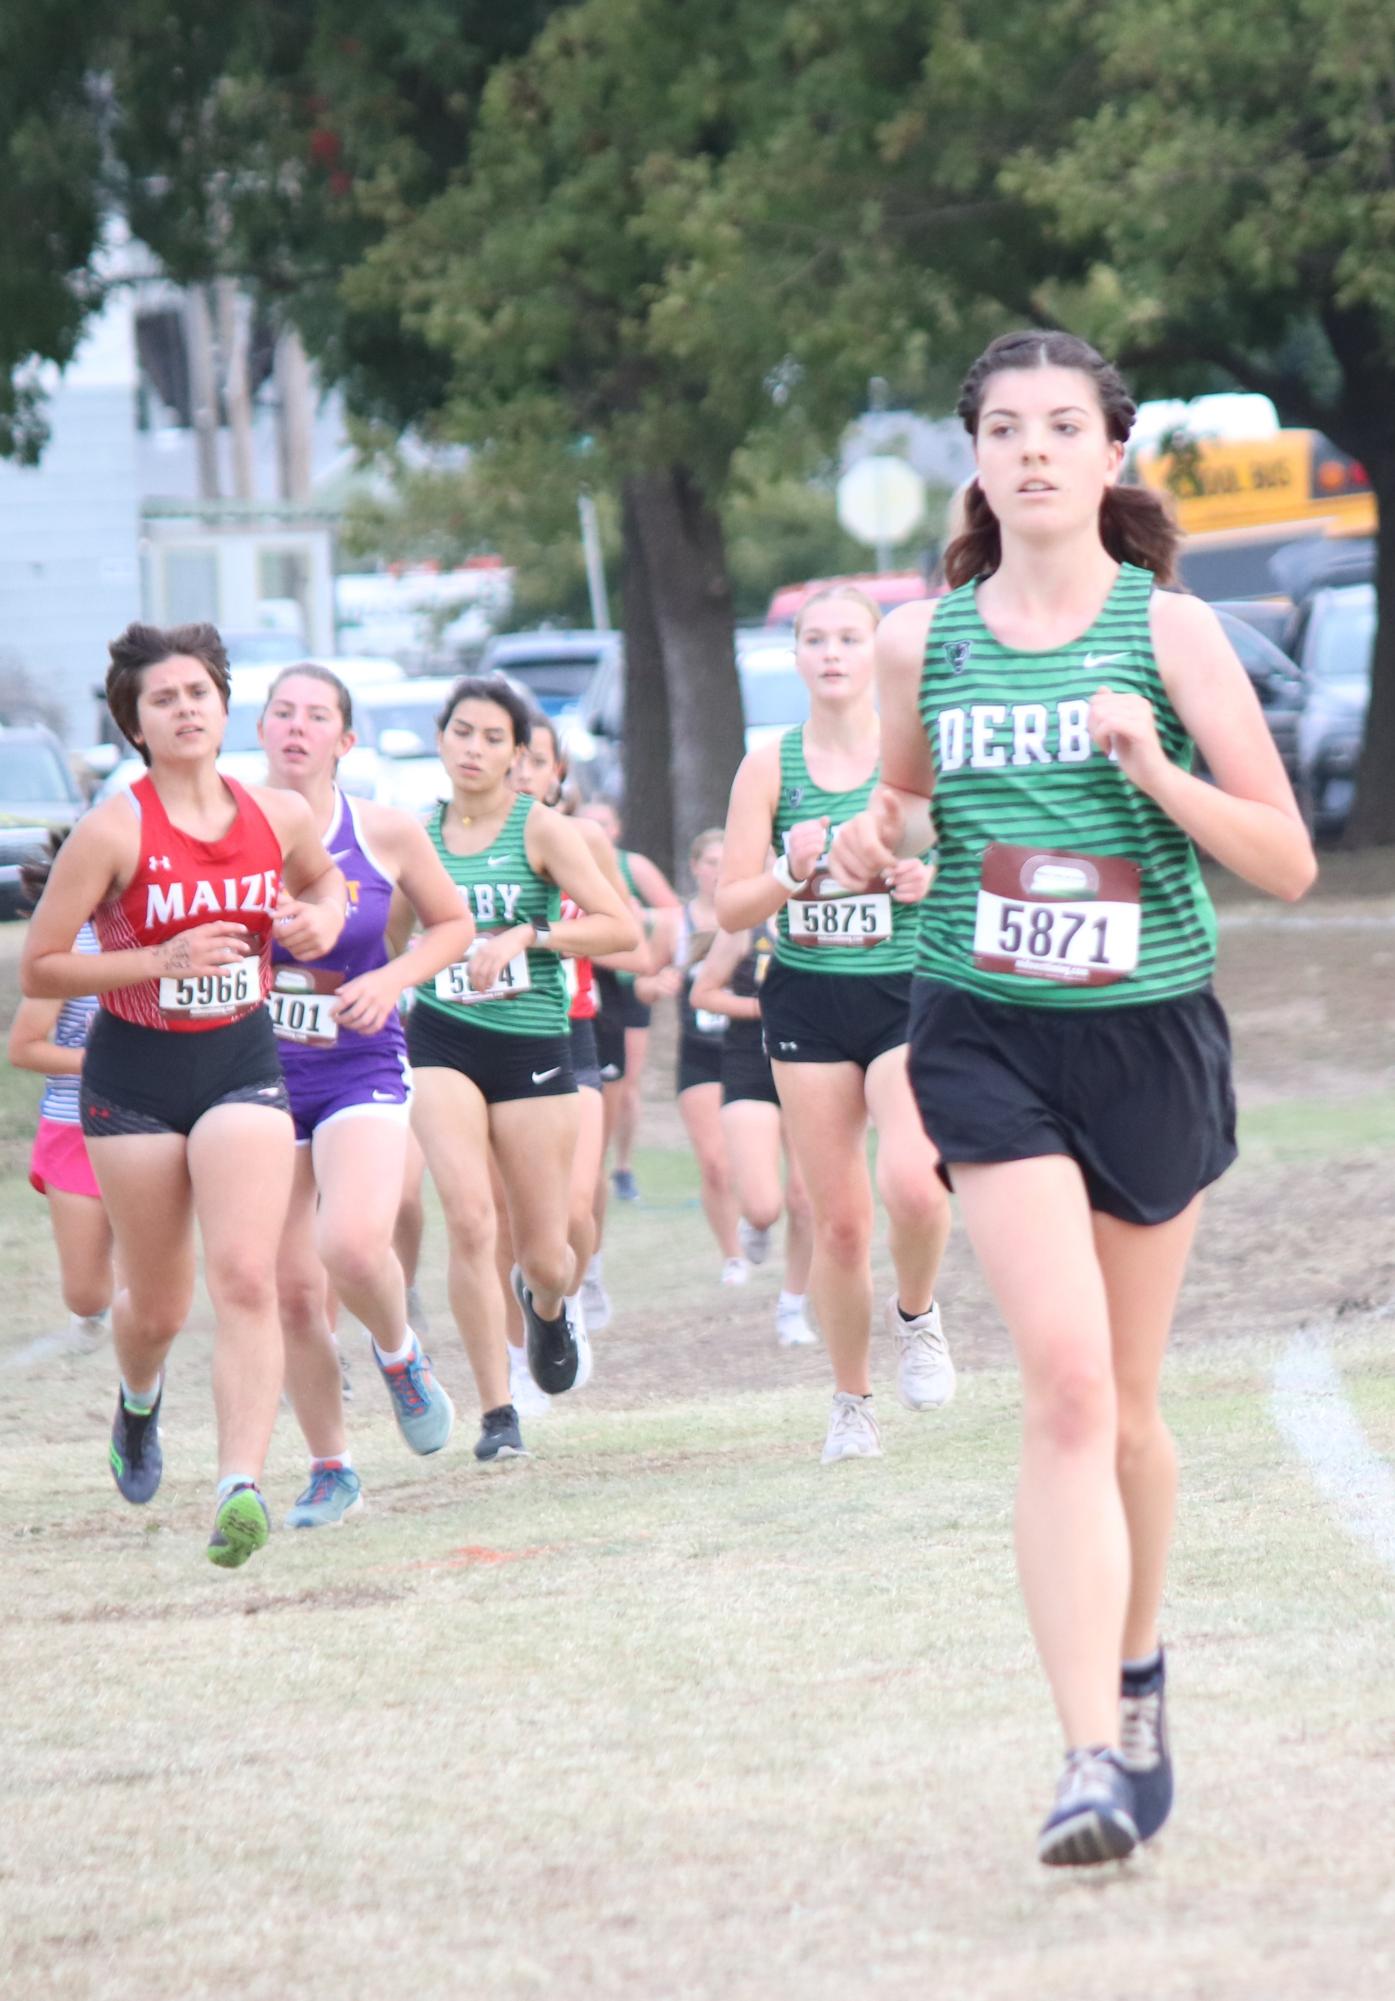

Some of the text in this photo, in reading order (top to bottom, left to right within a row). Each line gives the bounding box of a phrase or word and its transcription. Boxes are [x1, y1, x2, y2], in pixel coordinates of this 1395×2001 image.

[939, 699, 1119, 772] DERB
[145, 869, 278, 929] MAIZE
[801, 903, 877, 933] 5875
[999, 903, 1110, 965] 5871
[176, 969, 247, 1005] 5966
[449, 961, 515, 994] 54
[267, 995, 319, 1032] 101
